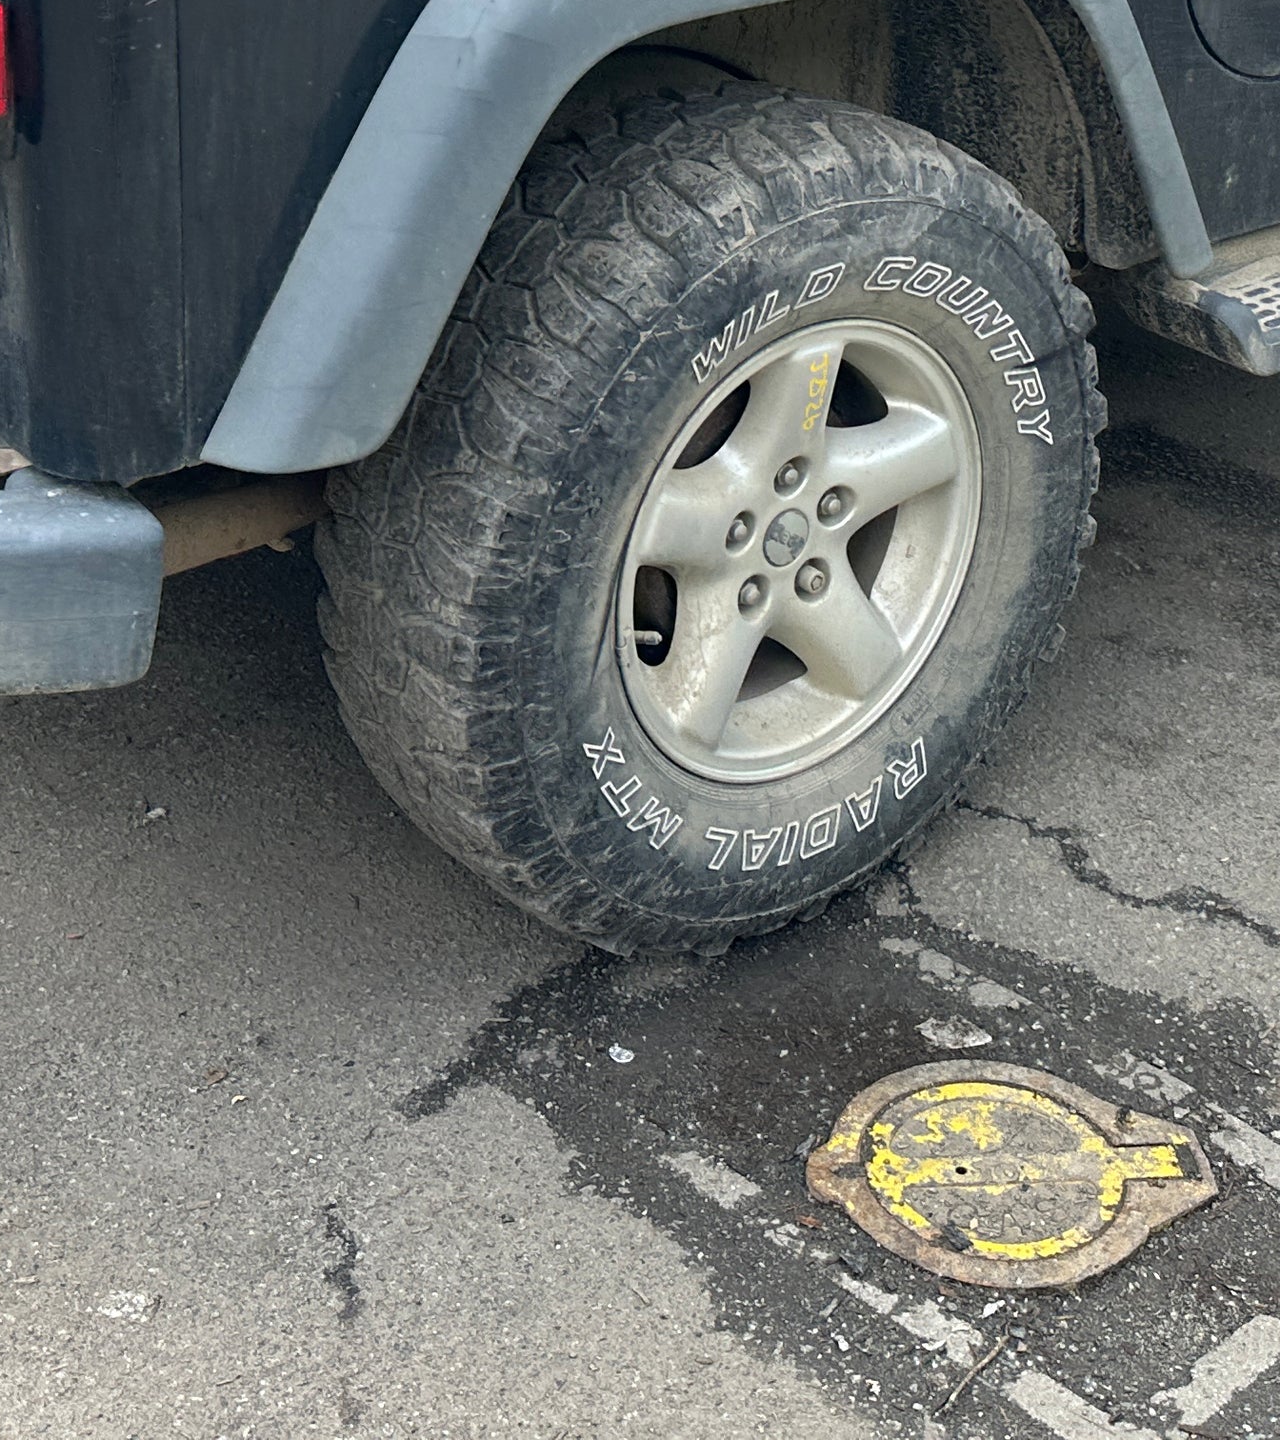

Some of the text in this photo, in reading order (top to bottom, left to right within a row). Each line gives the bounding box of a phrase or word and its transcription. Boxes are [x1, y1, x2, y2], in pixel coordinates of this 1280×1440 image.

[690, 256, 1054, 445] WILD COUNTRY
[582, 726, 928, 872] RADIAL MTX
